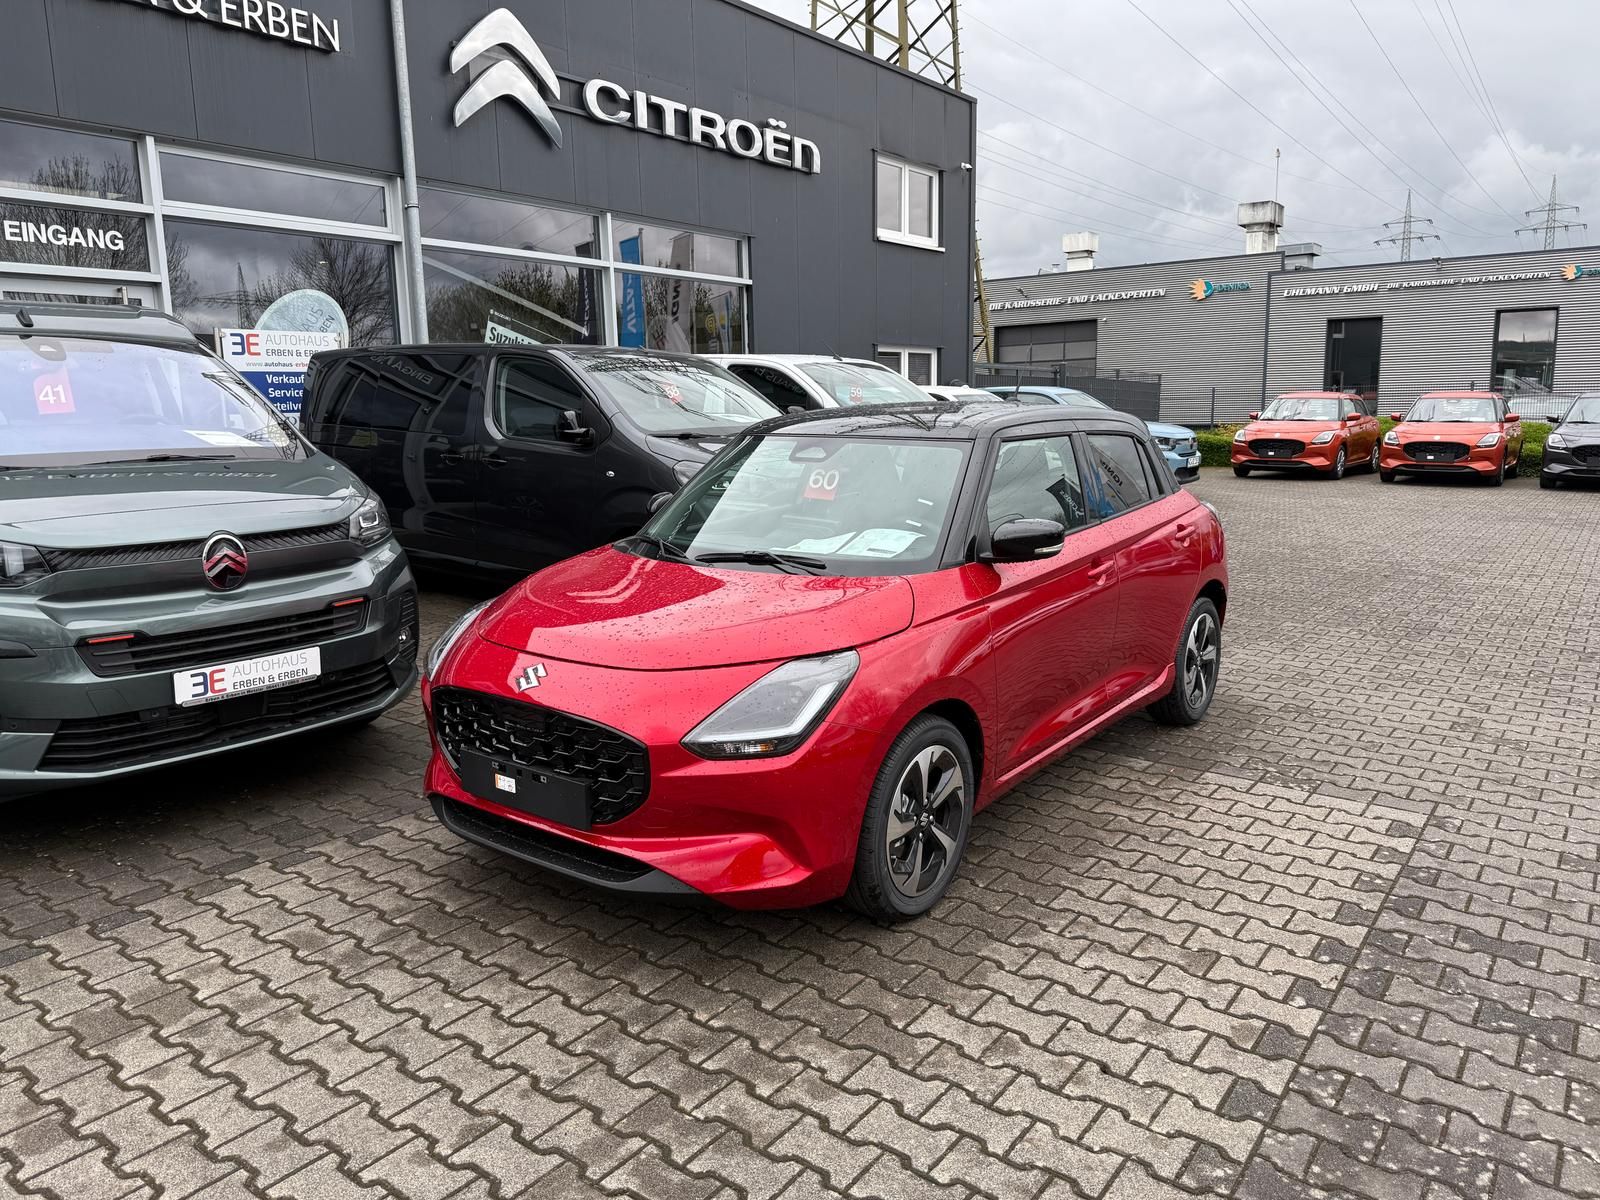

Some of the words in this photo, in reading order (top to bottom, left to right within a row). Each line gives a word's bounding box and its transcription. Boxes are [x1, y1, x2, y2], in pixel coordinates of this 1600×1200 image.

[220, 0, 340, 52] ERBEN
[3, 220, 125, 251] EINGANG
[265, 334, 330, 347] AUTOHAUS
[265, 349, 294, 357] ERBEN
[266, 374, 305, 384] Verkauf
[38, 384, 67, 405] 41
[850, 387, 863, 397] 59
[809, 469, 840, 491] 60
[232, 652, 308, 678] AUTOHAUS
[232, 676, 266, 690] ERBEN
[267, 674, 276, 683] &
[277, 667, 309, 681] ERBEN
